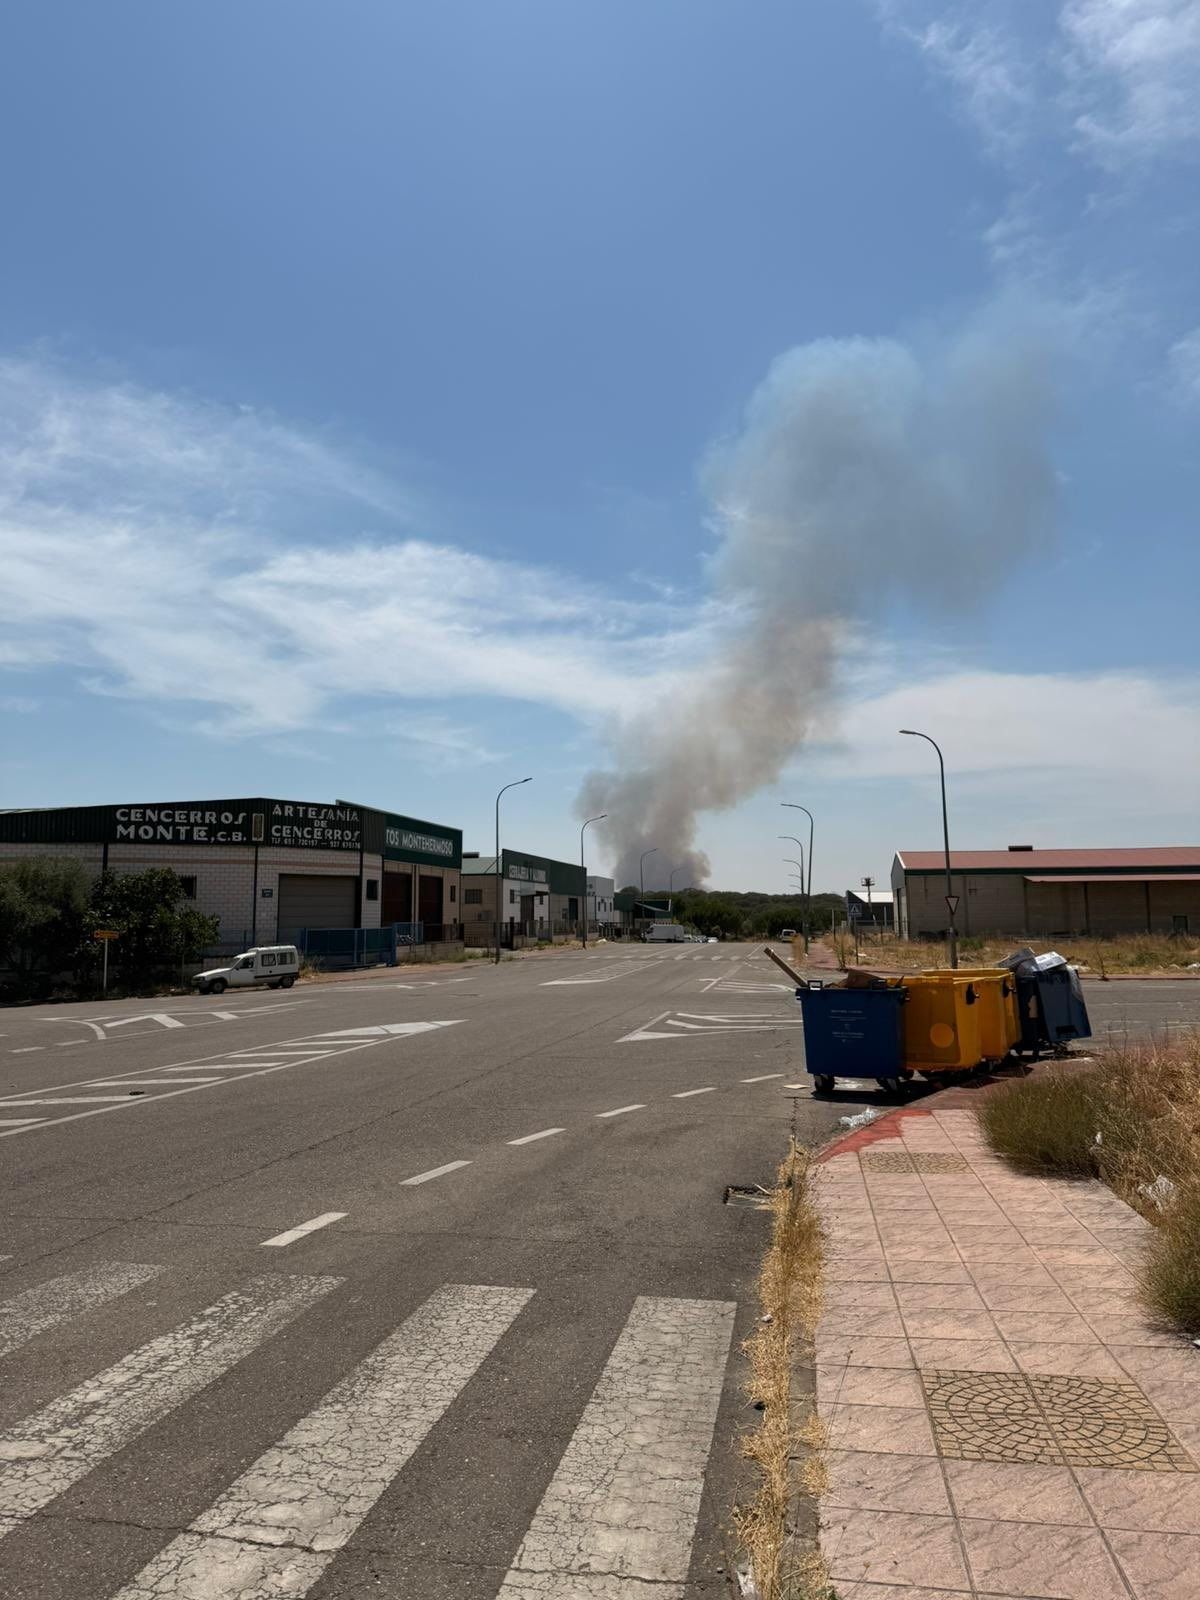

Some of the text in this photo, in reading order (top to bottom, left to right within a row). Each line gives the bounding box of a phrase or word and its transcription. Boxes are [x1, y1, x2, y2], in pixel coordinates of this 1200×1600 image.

[116, 808, 247, 825] CENCERROS
[272, 804, 360, 821] ARTESANÍA
[271, 825, 361, 841] CENCERROS
[402, 833, 454, 856] MONTEHERMOSO
